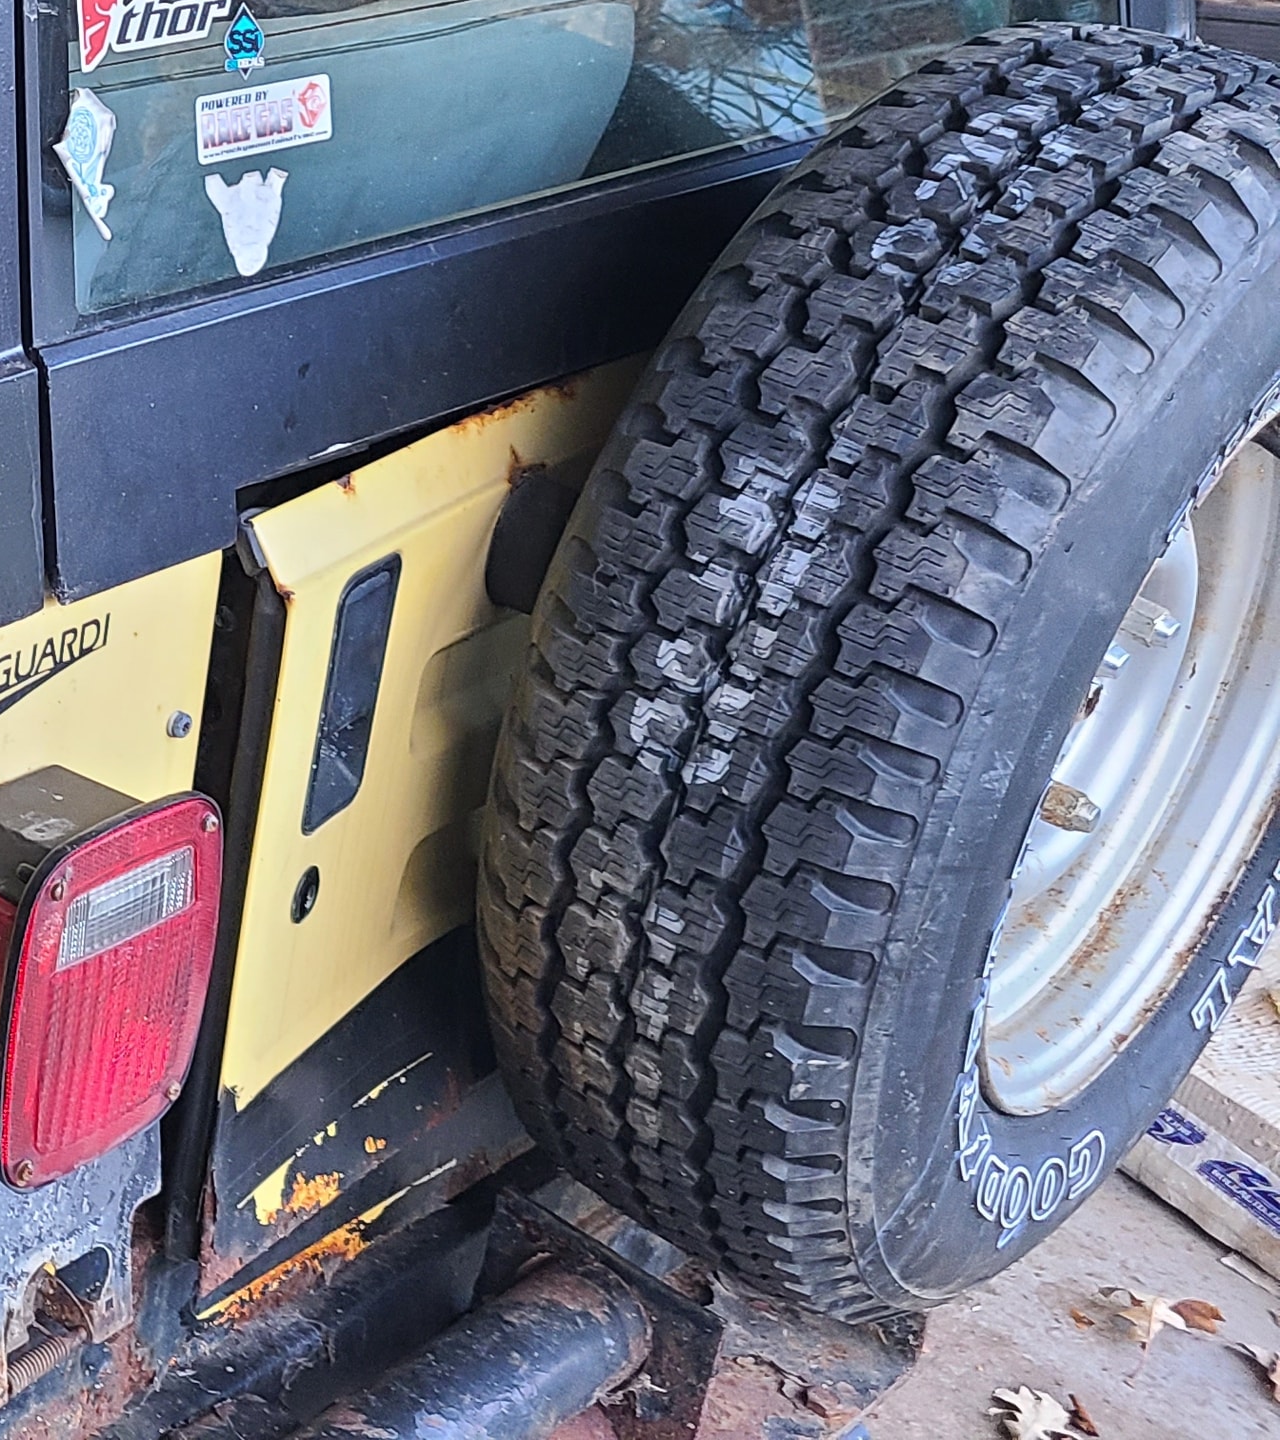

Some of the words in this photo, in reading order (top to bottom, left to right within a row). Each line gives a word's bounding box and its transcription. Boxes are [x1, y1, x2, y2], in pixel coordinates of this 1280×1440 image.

[201, 93, 252, 112] POWERED
[255, 90, 268, 101] BY
[201, 106, 251, 149] RACE
[254, 97, 293, 138] GAS
